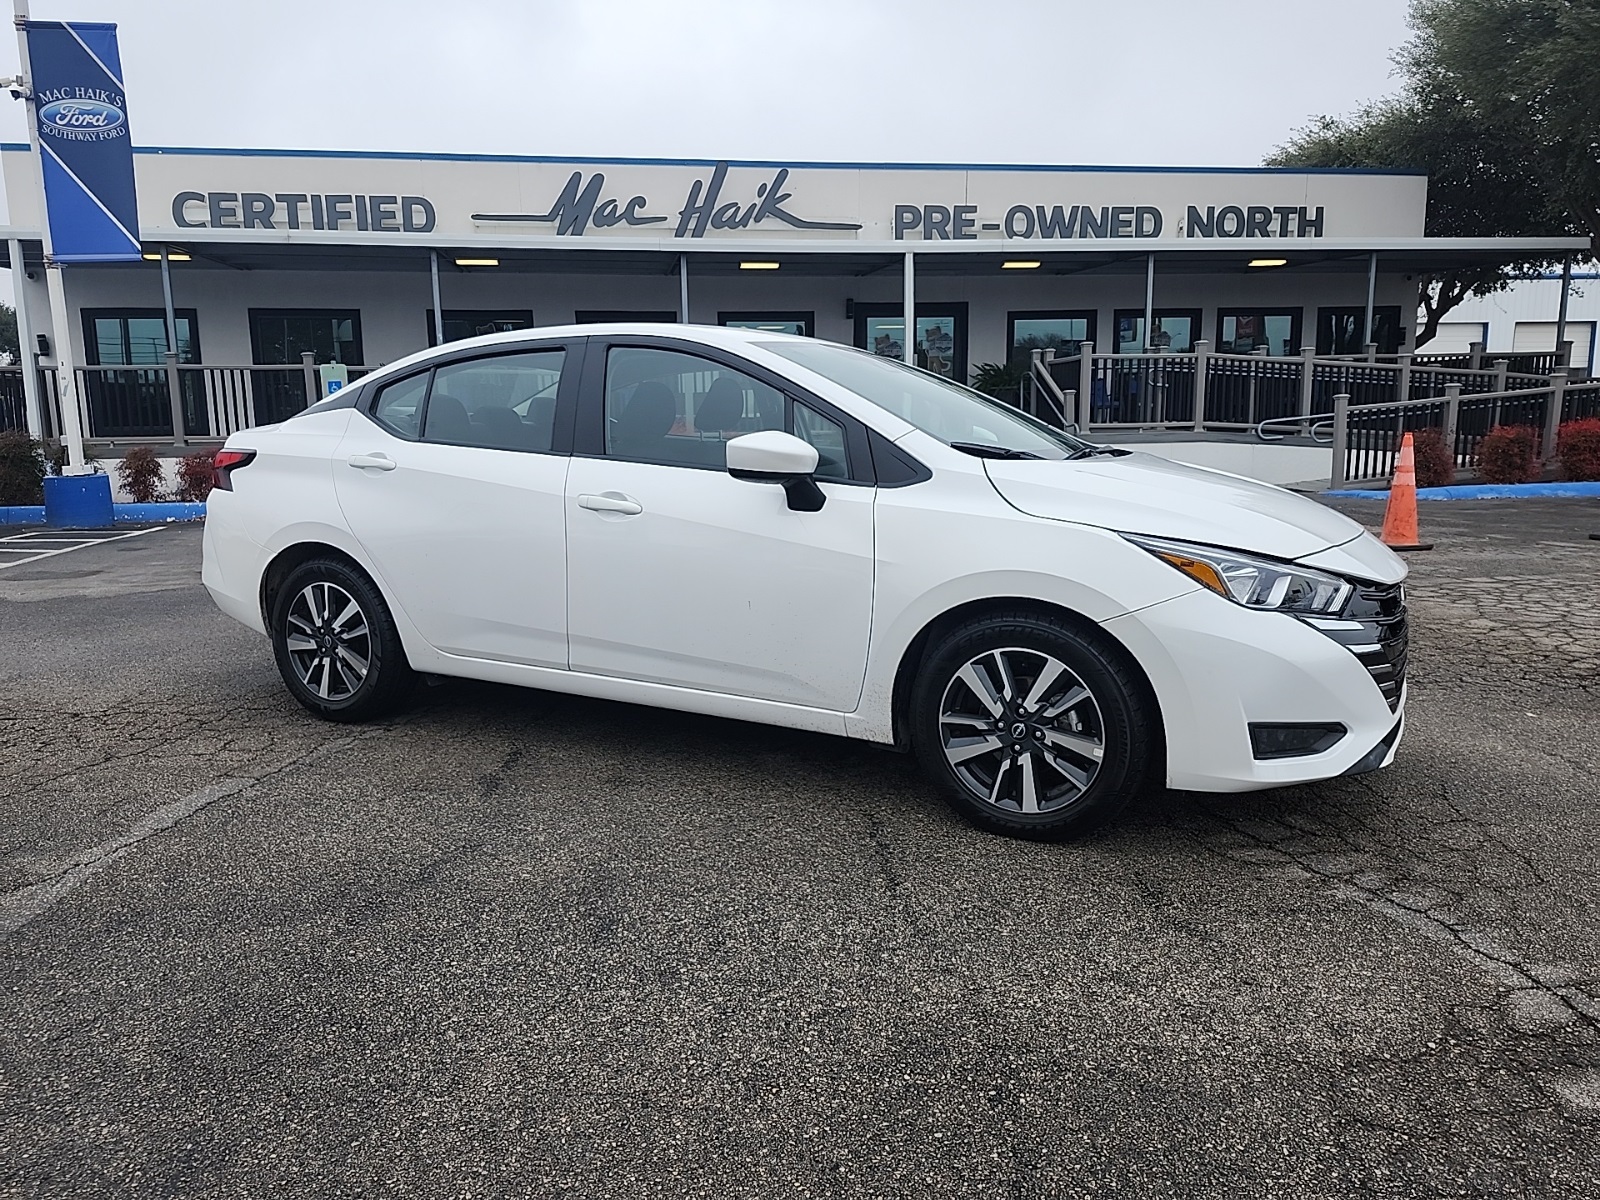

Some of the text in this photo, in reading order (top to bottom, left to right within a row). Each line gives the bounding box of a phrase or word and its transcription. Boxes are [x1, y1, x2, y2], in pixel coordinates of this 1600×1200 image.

[38, 87, 123, 107] MAC HAIK'S
[55, 104, 108, 126] Ford
[42, 124, 126, 142] SOUTHWAY FORD
[172, 191, 436, 233] CERTIFIED
[471, 161, 863, 238] Mac Haik
[893, 204, 1325, 240] PRE-OWNED NORTH
